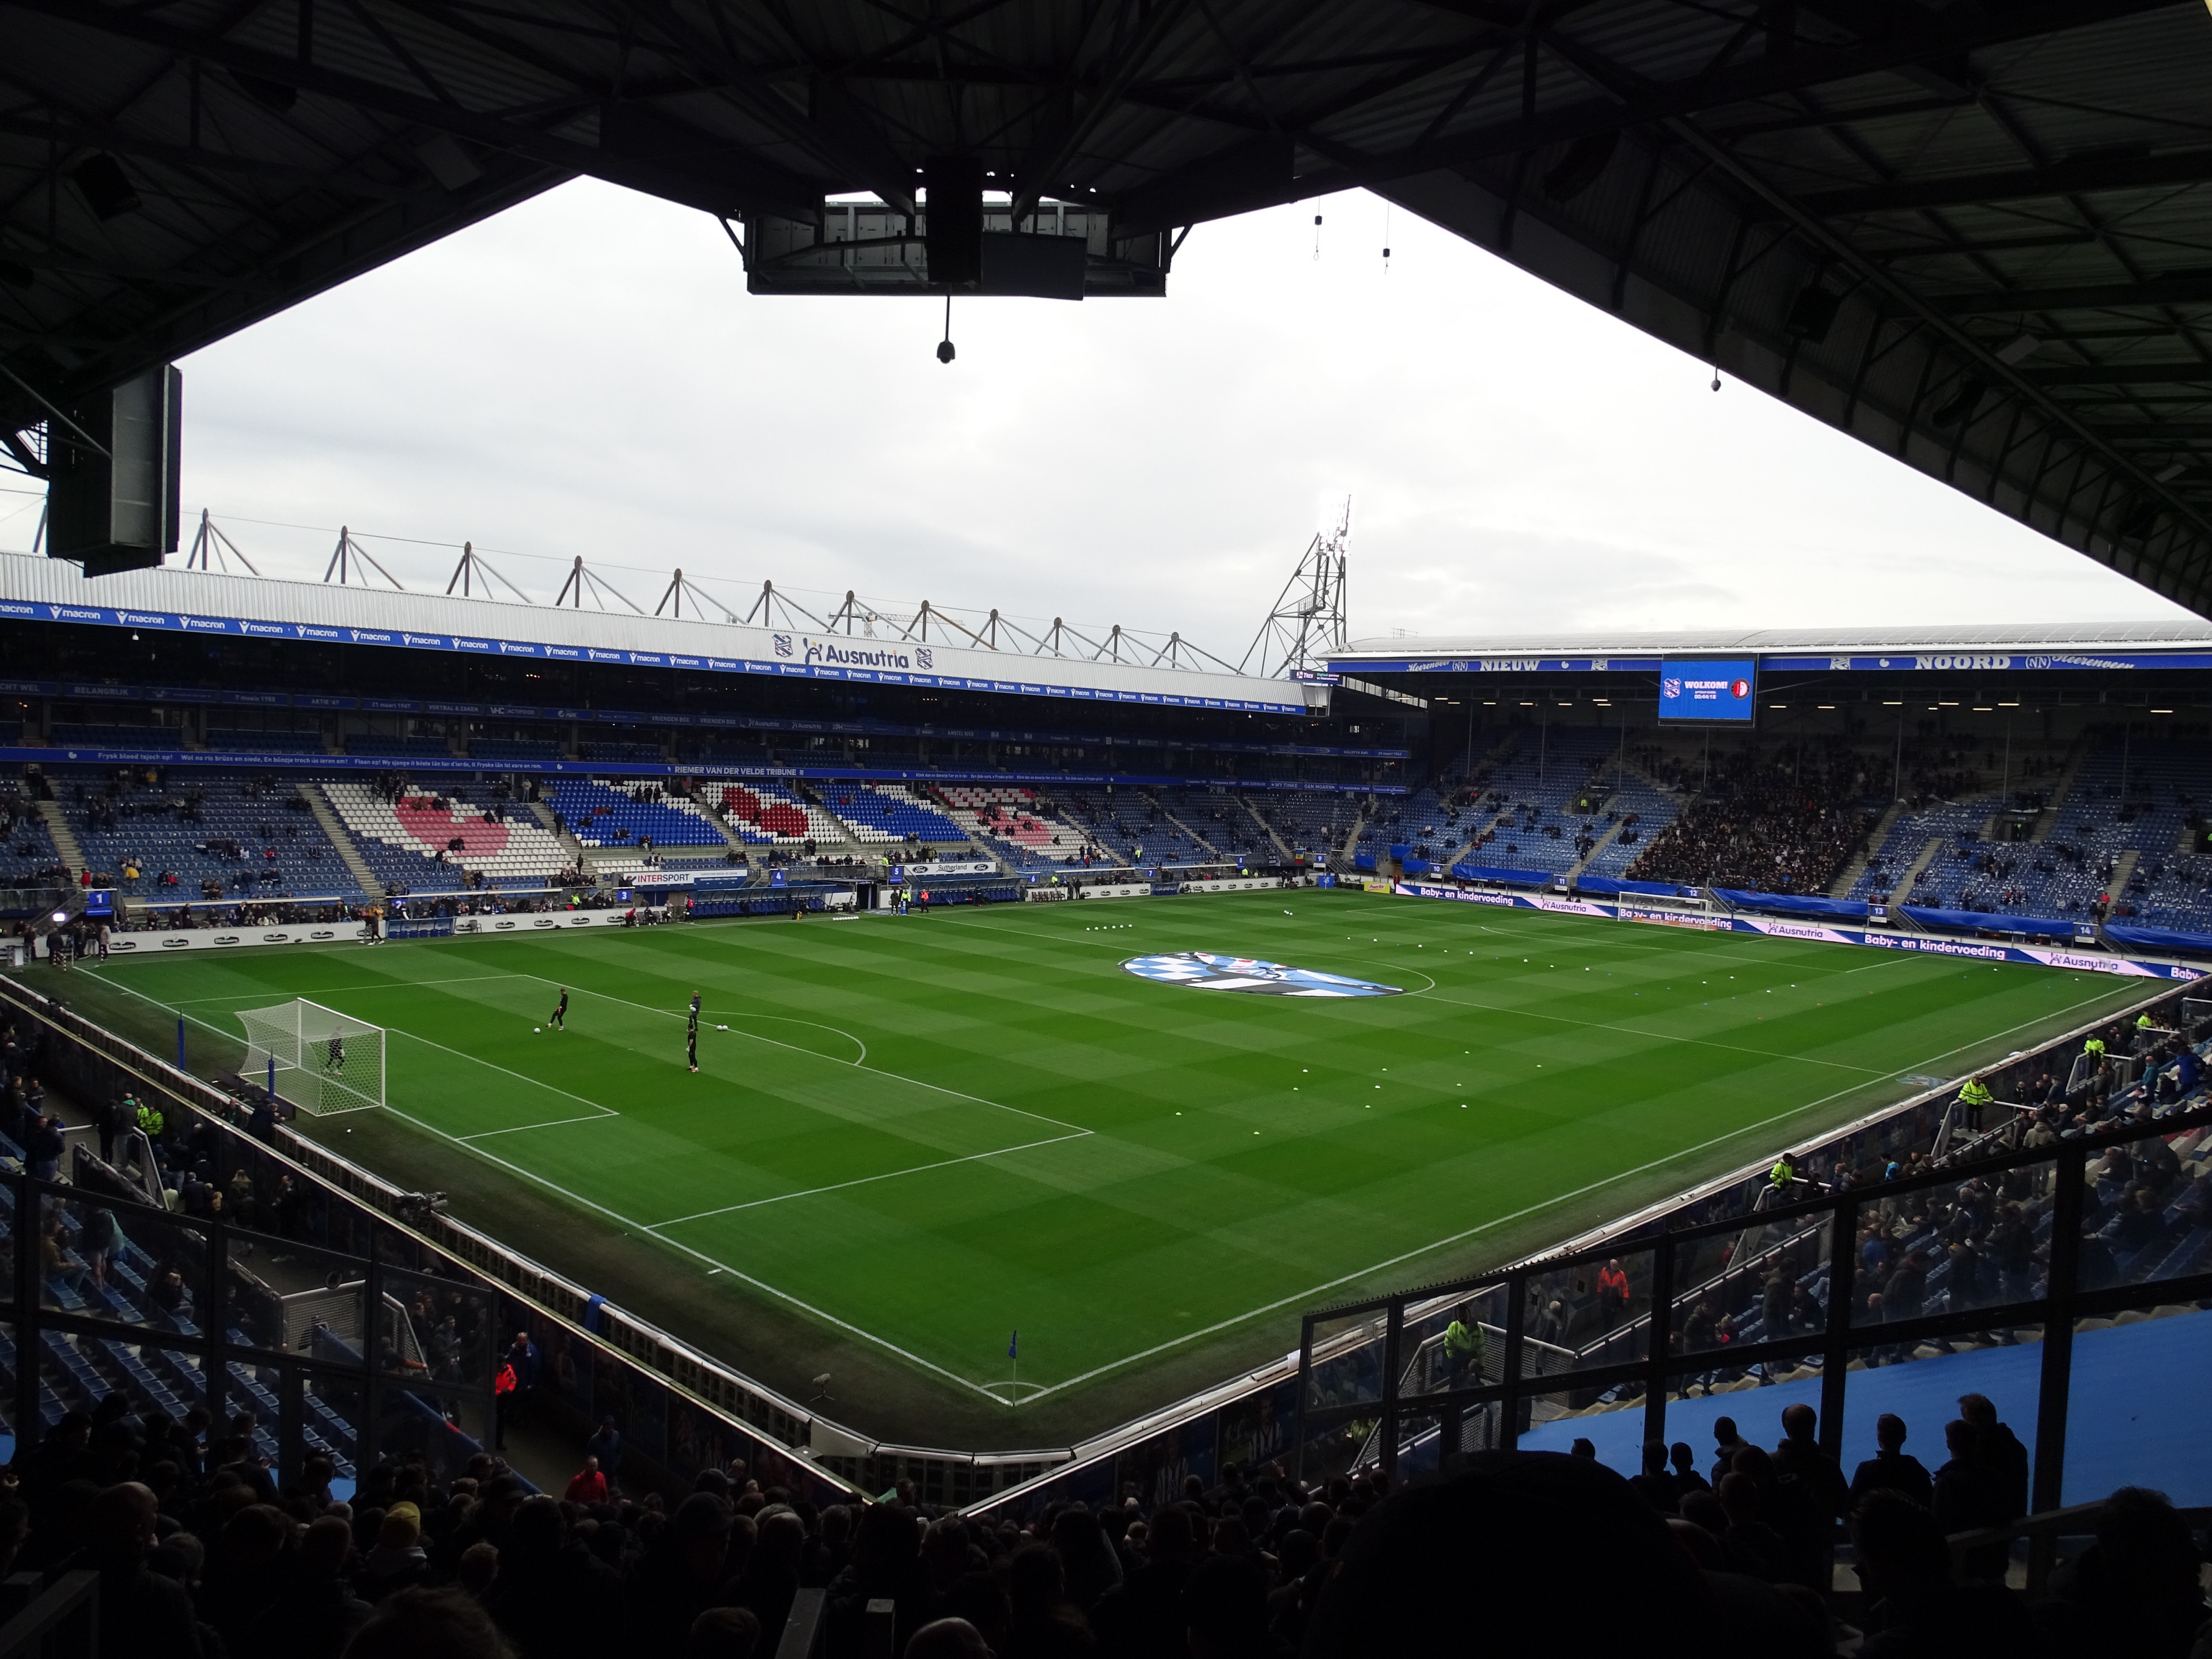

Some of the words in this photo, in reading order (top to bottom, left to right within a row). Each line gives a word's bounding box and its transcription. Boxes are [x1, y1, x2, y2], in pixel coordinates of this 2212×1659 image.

[63, 610, 100, 619] macron
[128, 615, 164, 624] macron
[191, 620, 225, 628] macron
[251, 625, 282, 633] macron
[307, 629, 338, 637] macron
[411, 638, 440, 647] macron
[826, 645, 909, 668] Ausnutria
[1480, 660, 1540, 672] NIEUW
[1915, 656, 2010, 669] NOORD
[74, 687, 129, 696] BELANGRIJK
[675, 766, 704, 774] RIEMER
[706, 766, 722, 774] VAN
[724, 767, 739, 775] DER
[740, 767, 764, 775] VELDE
[766, 768, 796, 776] TRIBUNE
[638, 874, 690, 882] INTERSPORT
[96, 893, 103, 903] 1
[622, 891, 627, 900] 3
[1421, 887, 1443, 899] Baby-
[1457, 891, 1513, 907] kindervoeding
[1550, 902, 1586, 912] Ausnutria
[1650, 912, 1661, 921] en
[1665, 912, 1732, 930] kindervoeding
[1779, 926, 1823, 938] Ausnutria
[2080, 926, 2091, 935] 14
[1865, 934, 1898, 948] Baby-
[1902, 940, 1916, 949] en
[1920, 940, 2006, 960] kindervoeding
[2063, 957, 2118, 970] Ausnutra
